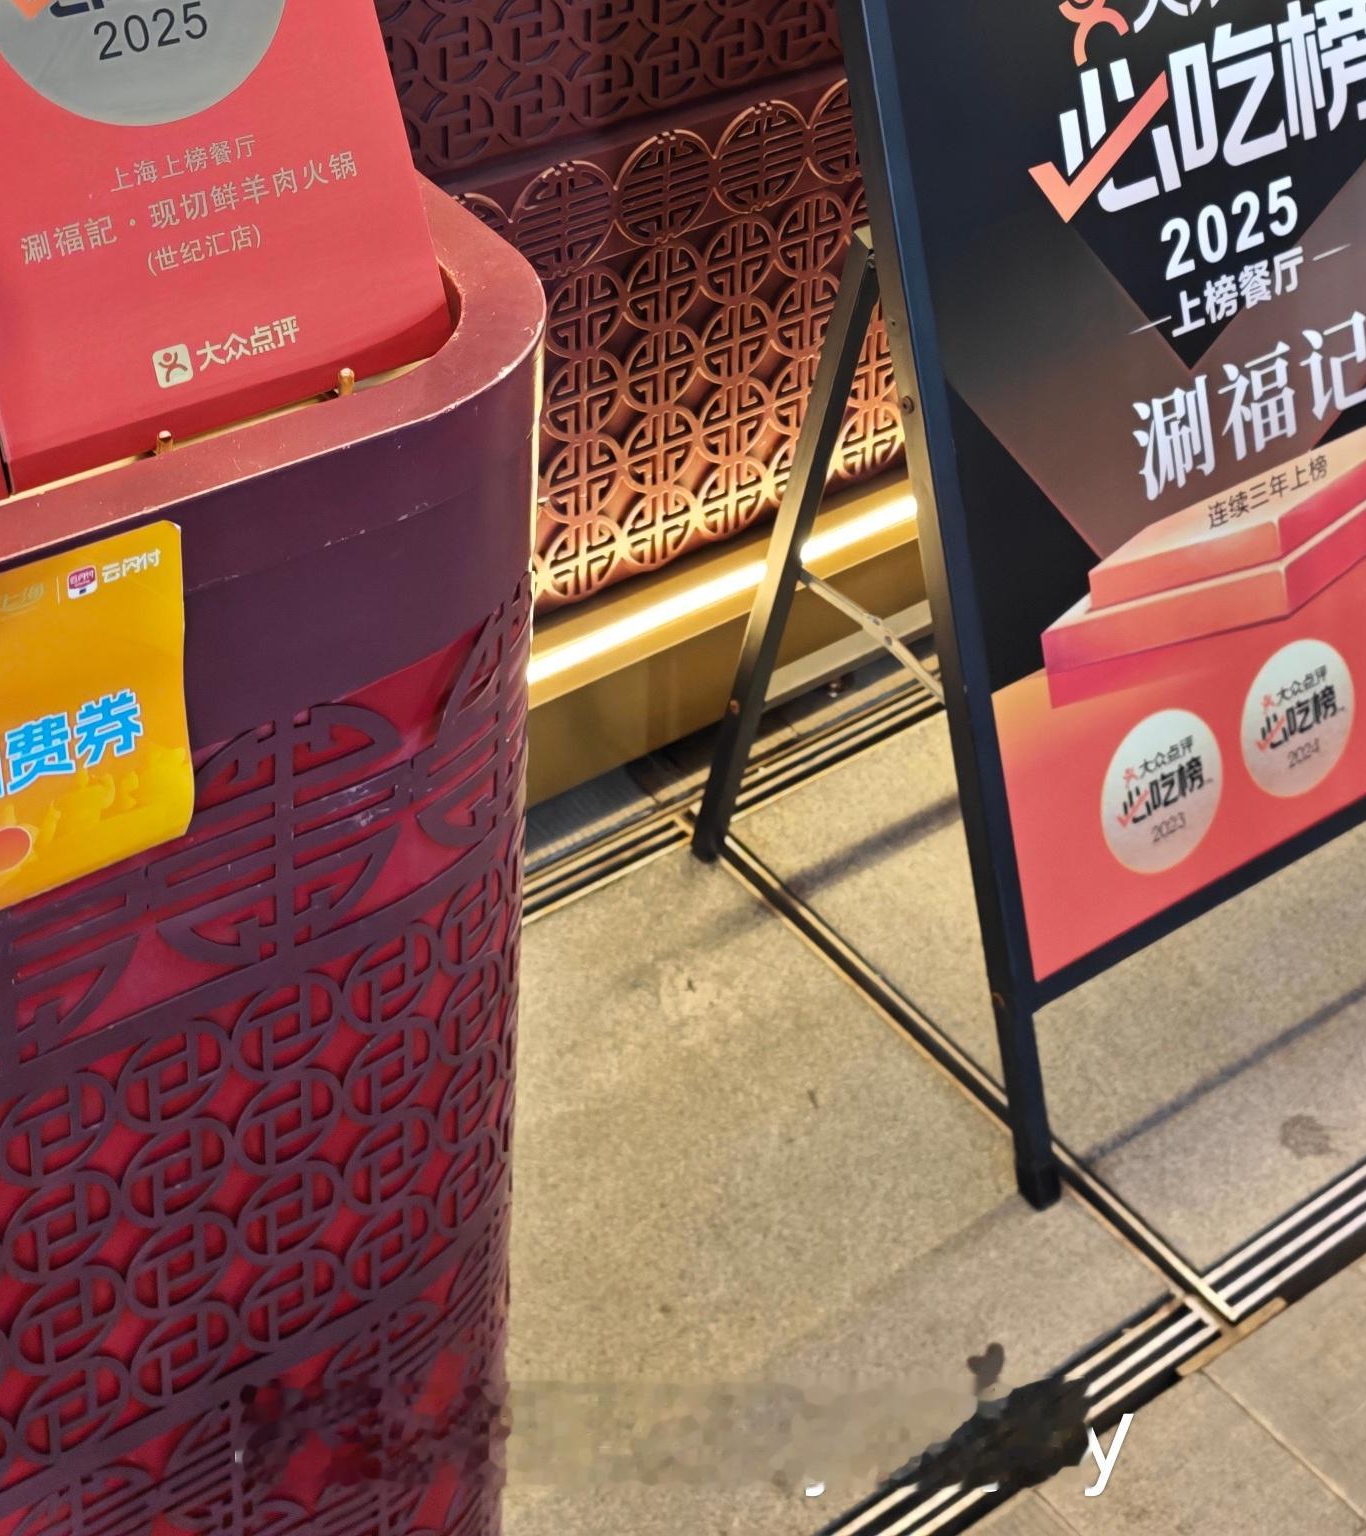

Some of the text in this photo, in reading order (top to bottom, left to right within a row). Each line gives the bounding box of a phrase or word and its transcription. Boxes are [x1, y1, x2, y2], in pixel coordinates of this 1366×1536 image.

[92, 0, 209, 62] 2025
[109, 134, 257, 196] 上海上榜餐厅
[146, 224, 263, 279] (世纪汇店)
[1160, 176, 1299, 281] 2025
[1172, 246, 1304, 337] 上榜餐厅
[196, 315, 302, 370] 大众点评
[1208, 455, 1328, 529] 连续三年上榜
[102, 549, 160, 584] 云闪付
[1276, 665, 1328, 703] 大众点评
[1256, 684, 1338, 752] 必吃榜
[1138, 735, 1194, 779] 大众点评
[1288, 738, 1322, 769] 2024
[1117, 755, 1205, 828] 必吃榜
[1151, 811, 1187, 843] 2023
